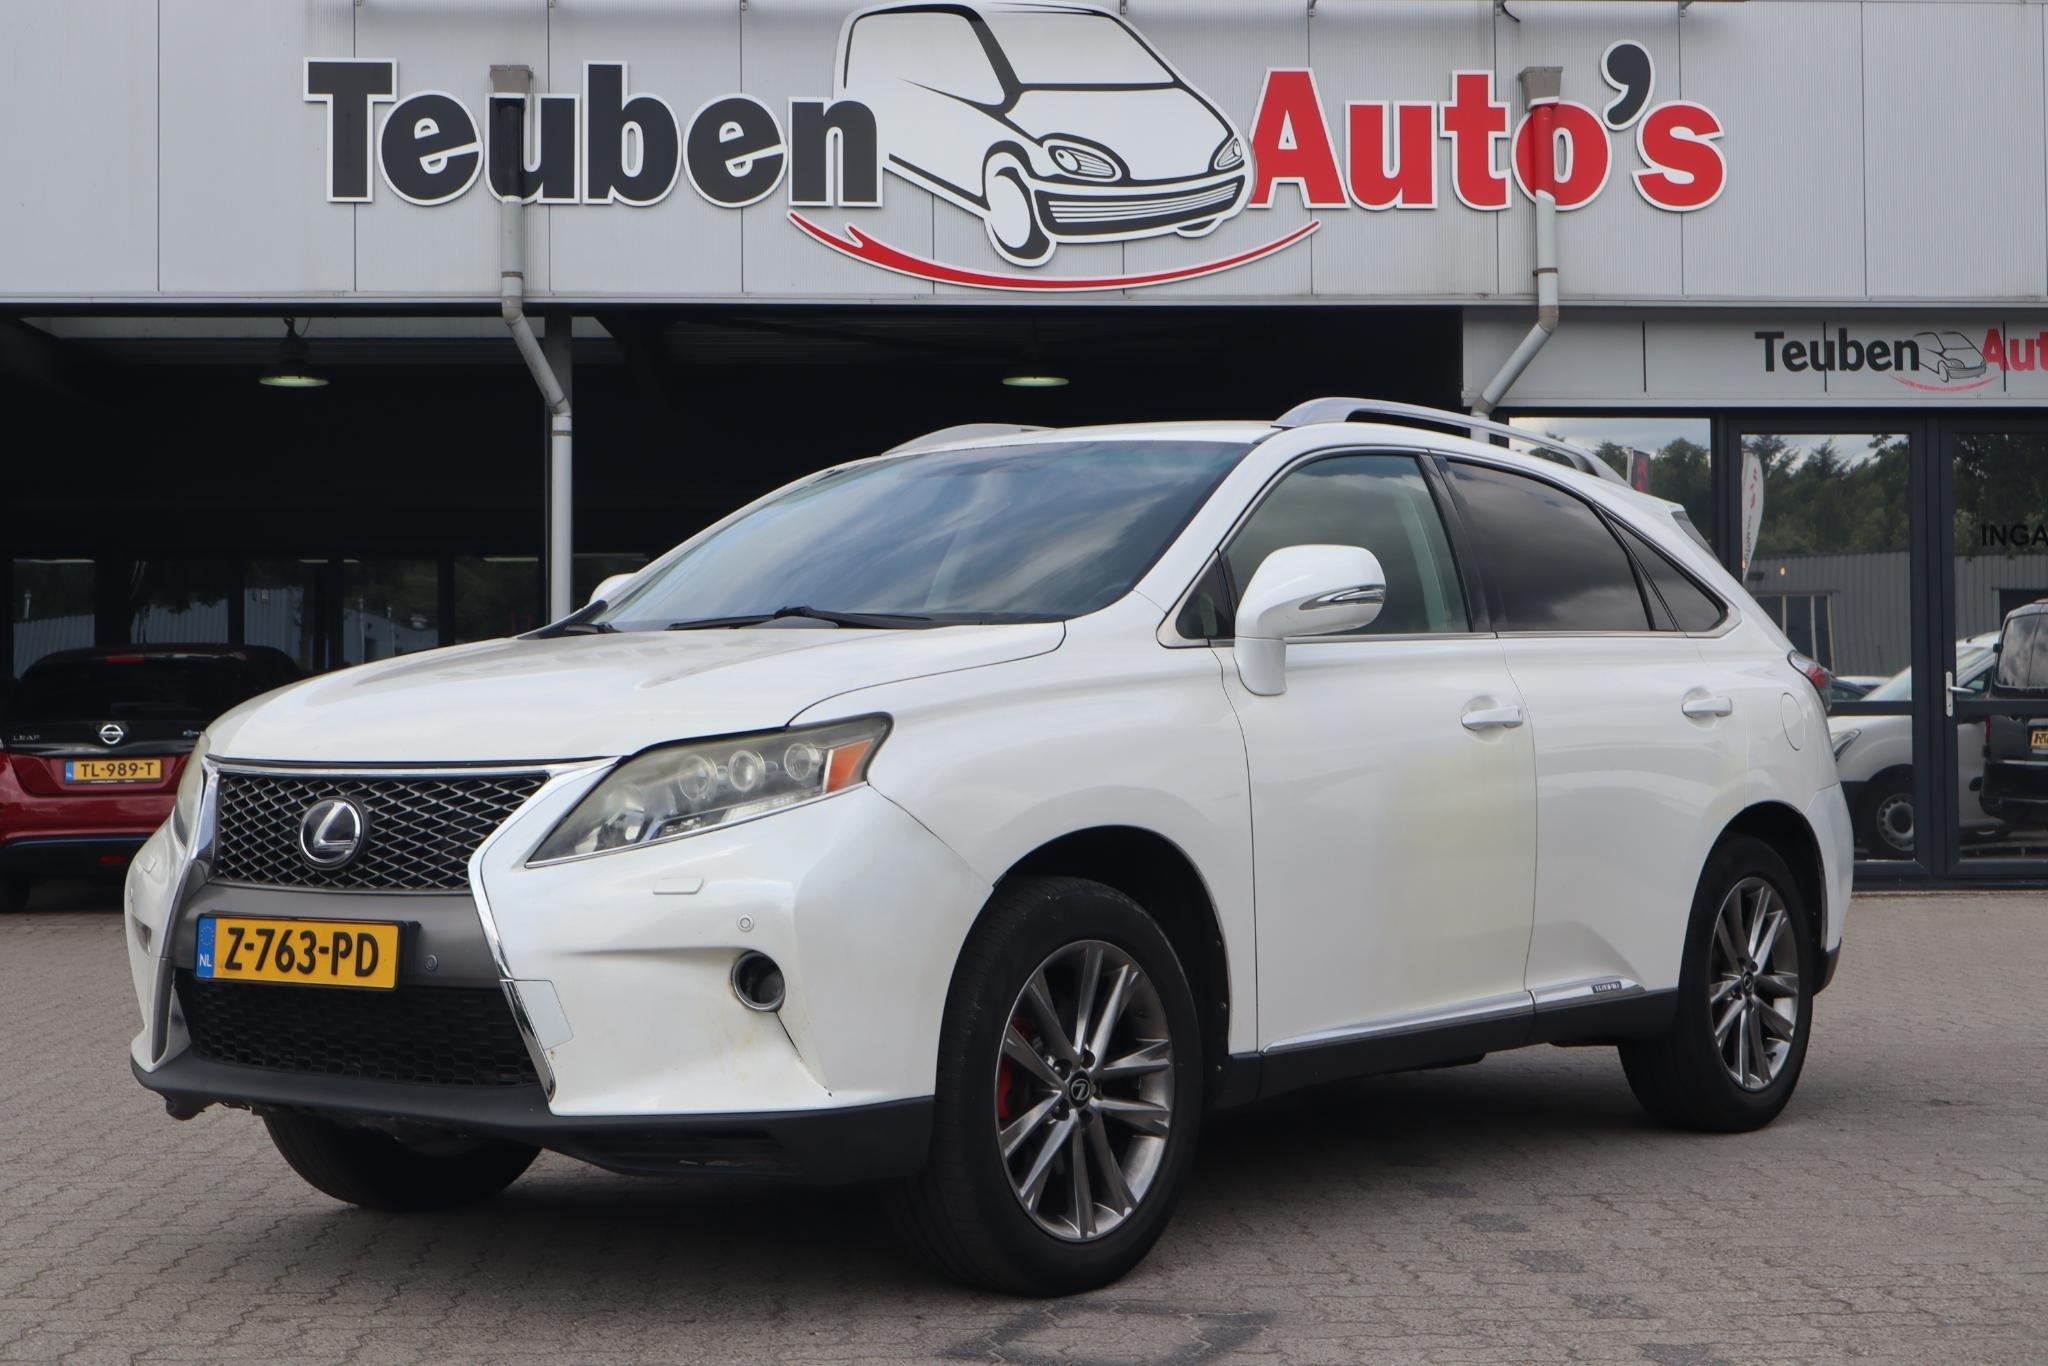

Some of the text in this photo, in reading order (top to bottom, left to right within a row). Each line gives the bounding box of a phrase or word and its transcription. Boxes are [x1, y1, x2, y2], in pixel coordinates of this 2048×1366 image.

[305, 41, 1726, 209] Teuben Auto's
[1755, 328, 1919, 372] Teuben
[81, 762, 153, 777] TL-989-T
[200, 952, 212, 967] NL
[225, 927, 379, 977] Z-763-PD
